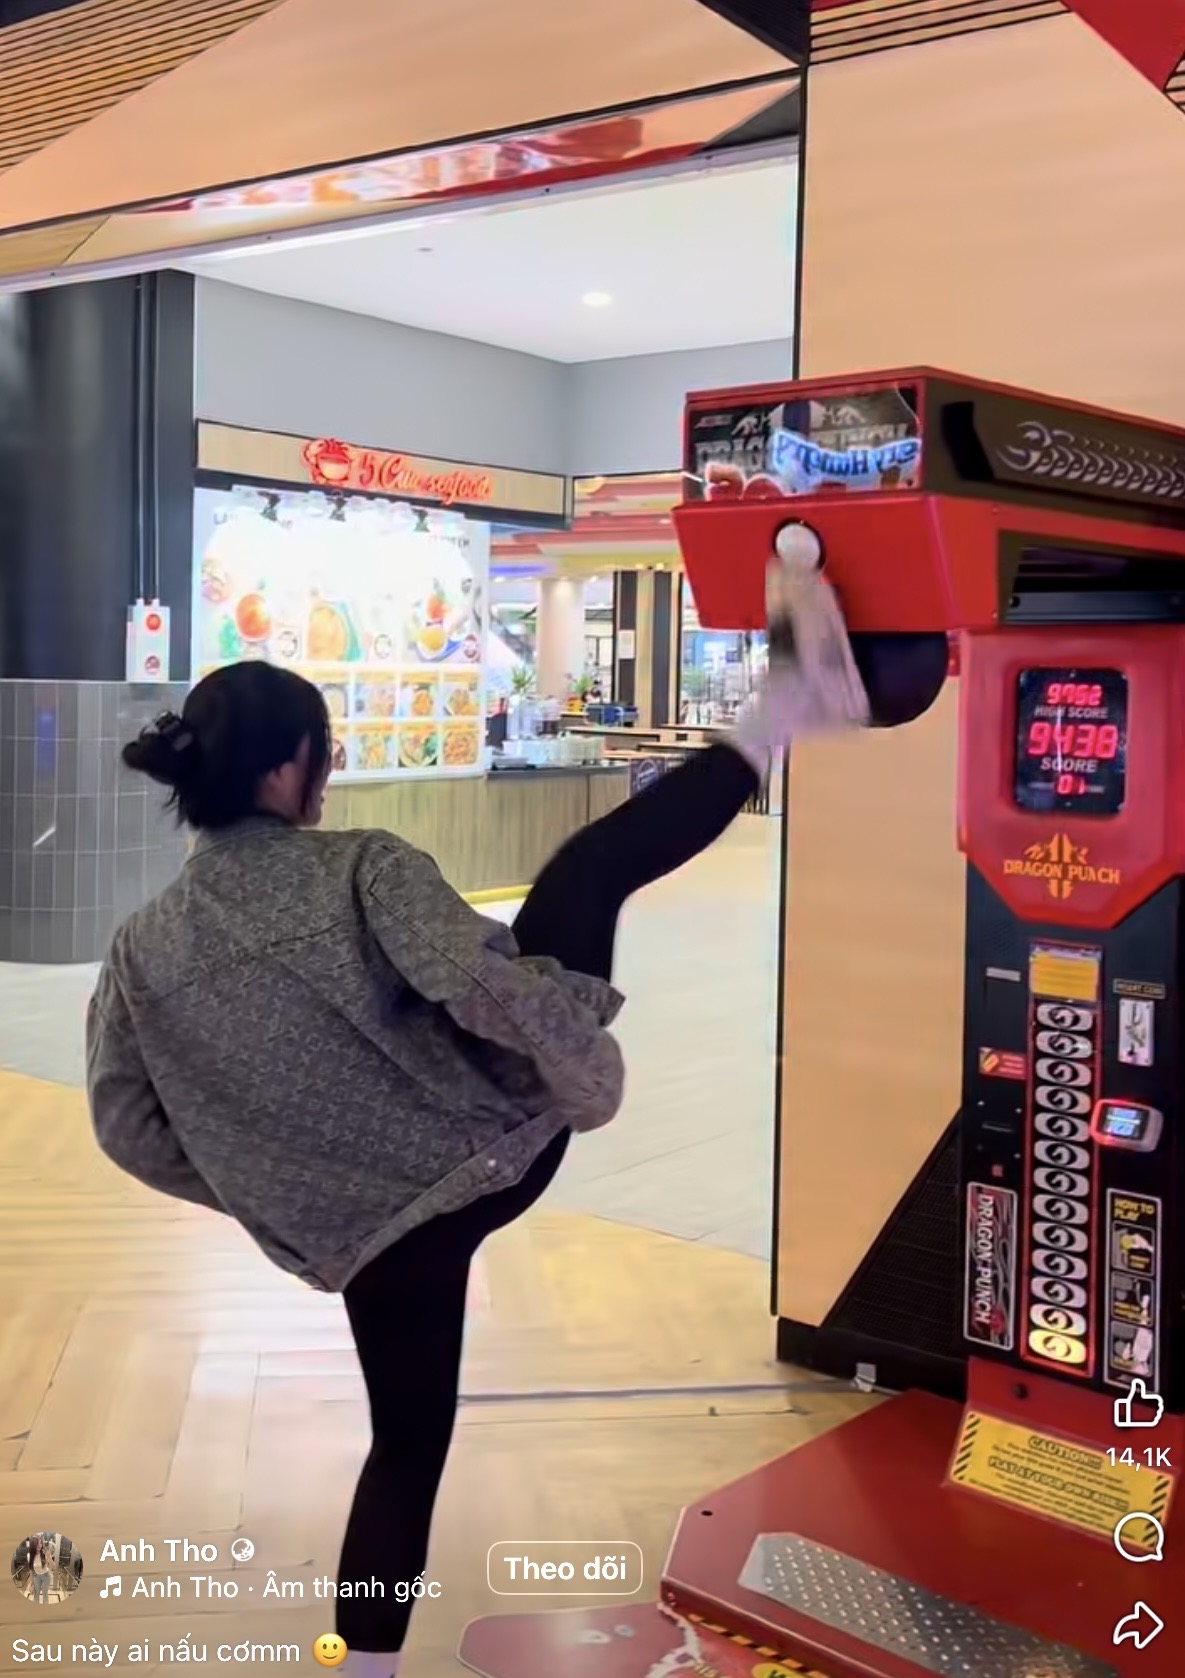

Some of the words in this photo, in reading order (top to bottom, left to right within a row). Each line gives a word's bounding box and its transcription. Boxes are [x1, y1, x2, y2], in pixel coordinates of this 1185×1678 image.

[1047, 683, 1102, 706] 9752
[1034, 706, 1066, 716] HIGH
[1067, 707, 1109, 719] SCORE
[1028, 721, 1118, 758] 9438
[1040, 757, 1098, 773] SCORE
[1003, 859, 1063, 879] DRAGON
[1067, 864, 1120, 885] PUNCH
[976, 1194, 994, 1257] DRAGON
[974, 1266, 993, 1325] PUNCH
